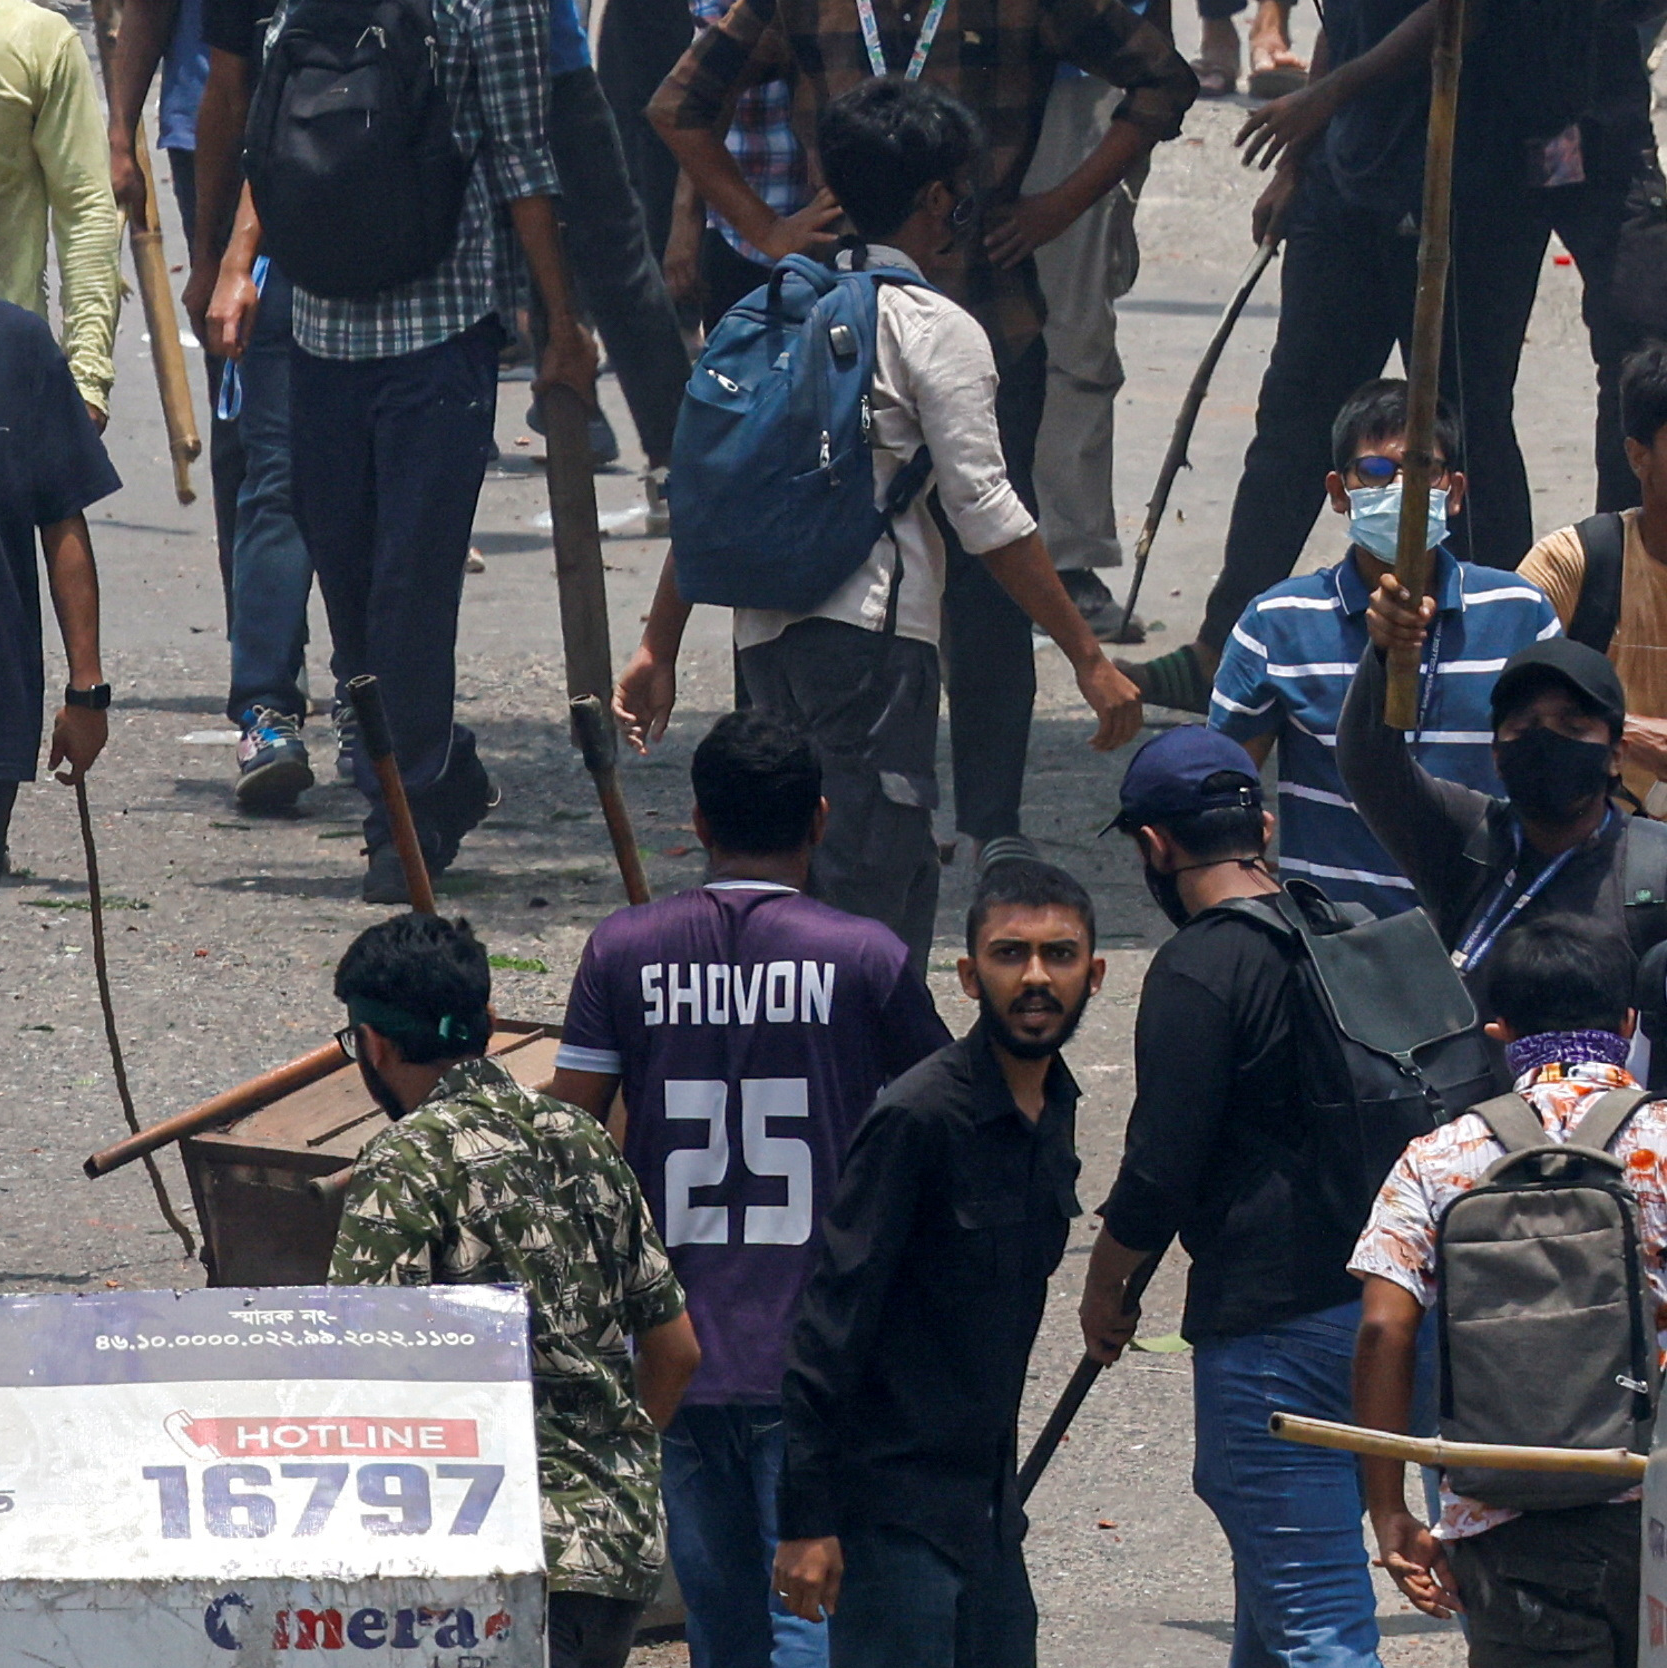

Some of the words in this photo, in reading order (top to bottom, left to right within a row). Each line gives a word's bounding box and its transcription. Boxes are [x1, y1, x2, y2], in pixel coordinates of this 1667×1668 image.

[641, 961, 835, 1026] SHOVON
[665, 1078, 812, 1247] 25
[228, 1309, 294, 1326] স্মারক
[237, 1424, 447, 1450] HOTLINE
[142, 1462, 506, 1540] 16797
